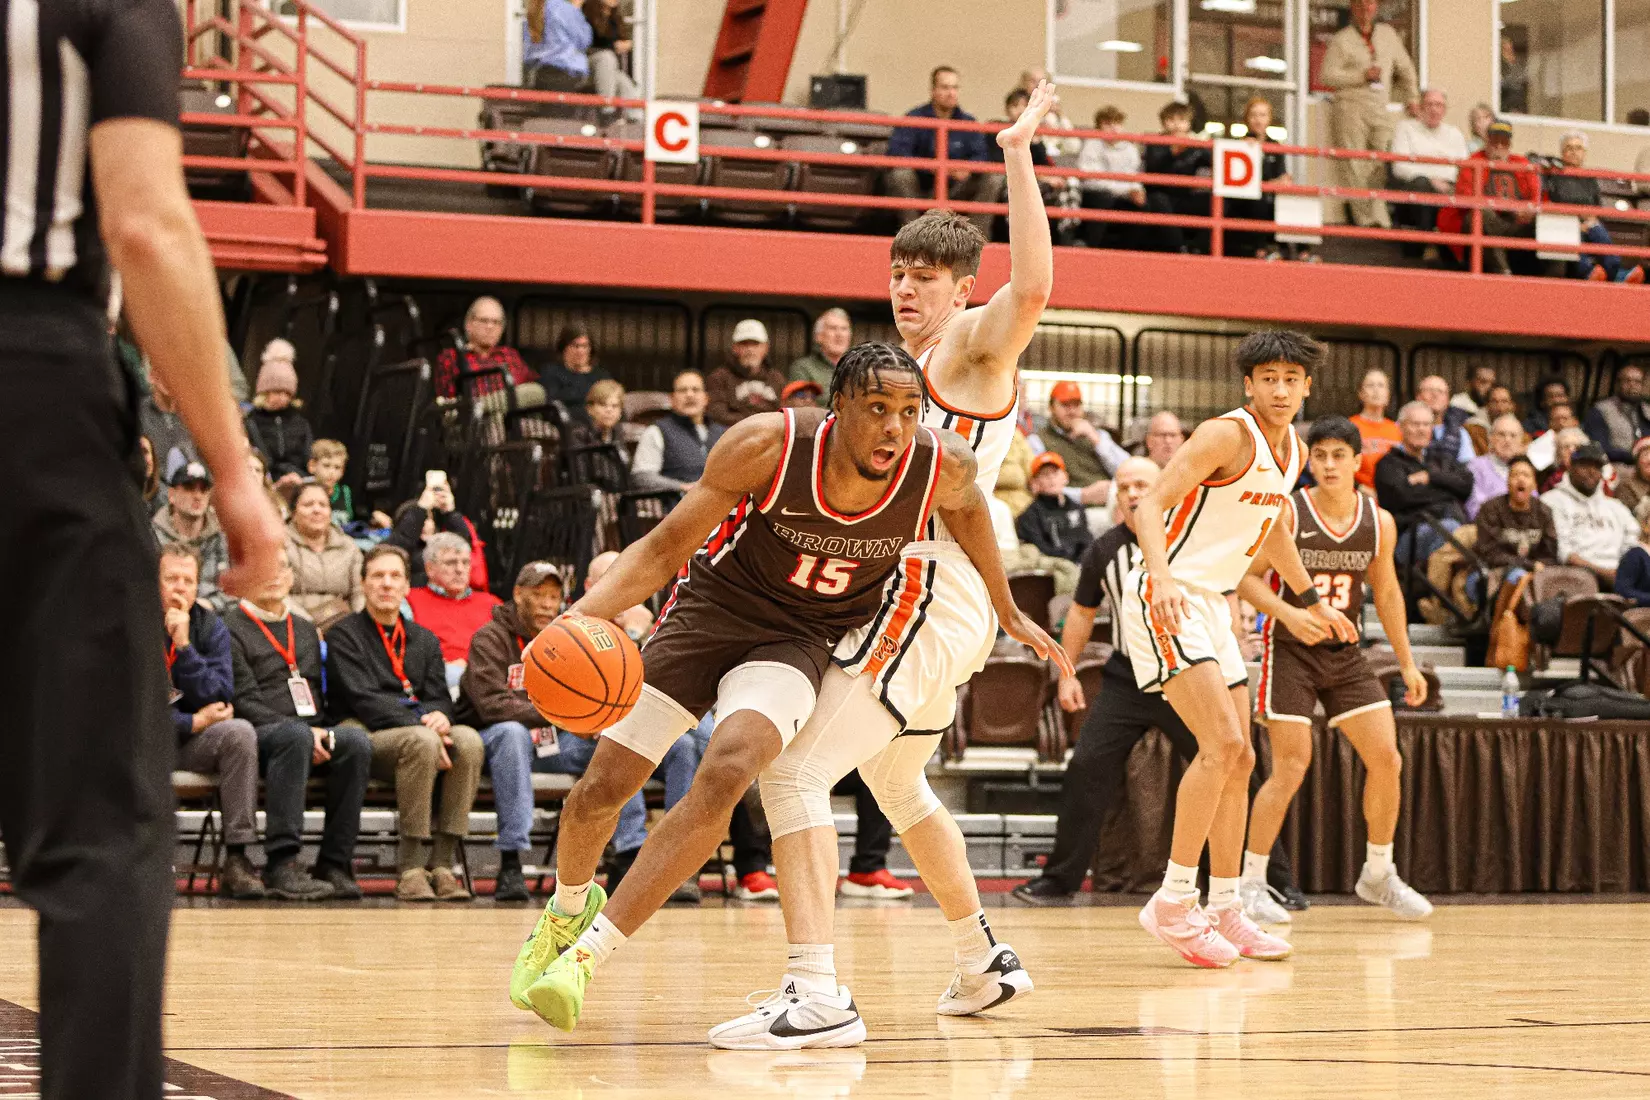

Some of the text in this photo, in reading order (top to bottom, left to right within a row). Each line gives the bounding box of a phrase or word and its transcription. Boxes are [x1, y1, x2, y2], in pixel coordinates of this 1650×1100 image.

[654, 112, 689, 152] C
[1222, 150, 1254, 187] D
[774, 522, 903, 558] BROWN
[1244, 517, 1272, 557] 1
[787, 552, 861, 597] 15
[1300, 548, 1372, 572] BROWN
[1313, 572, 1353, 610] 23
